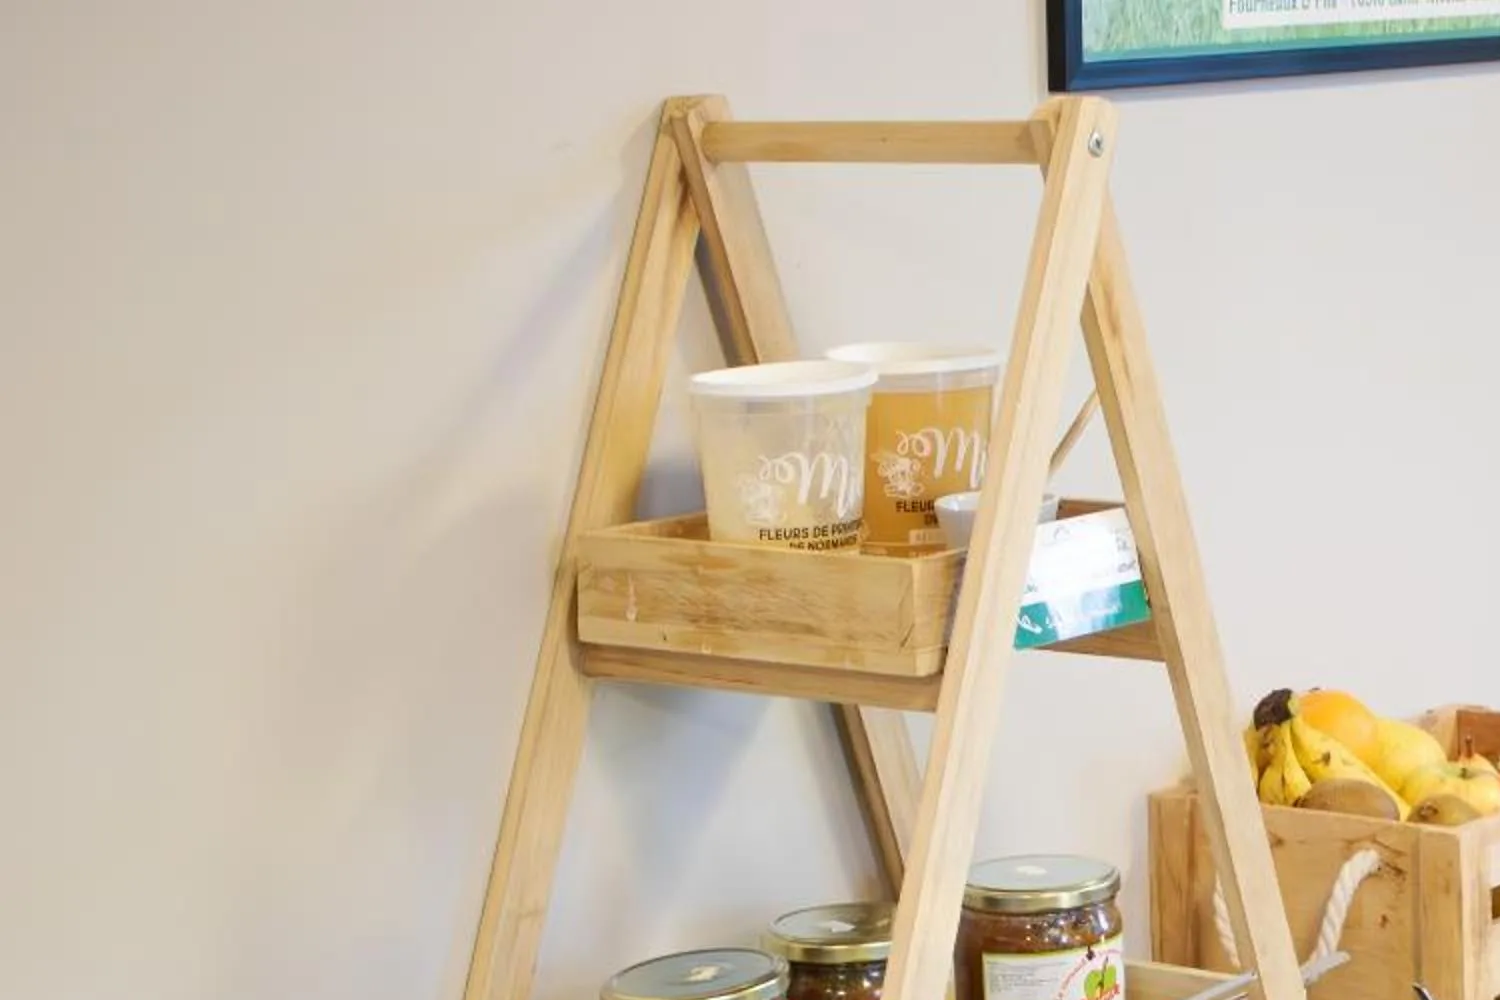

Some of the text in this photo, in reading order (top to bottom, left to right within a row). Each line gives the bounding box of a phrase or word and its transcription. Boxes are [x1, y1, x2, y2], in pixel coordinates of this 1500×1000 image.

[896, 499, 935, 513] FLEUR
[759, 525, 809, 541] FLEURS
[813, 525, 829, 539] DE
